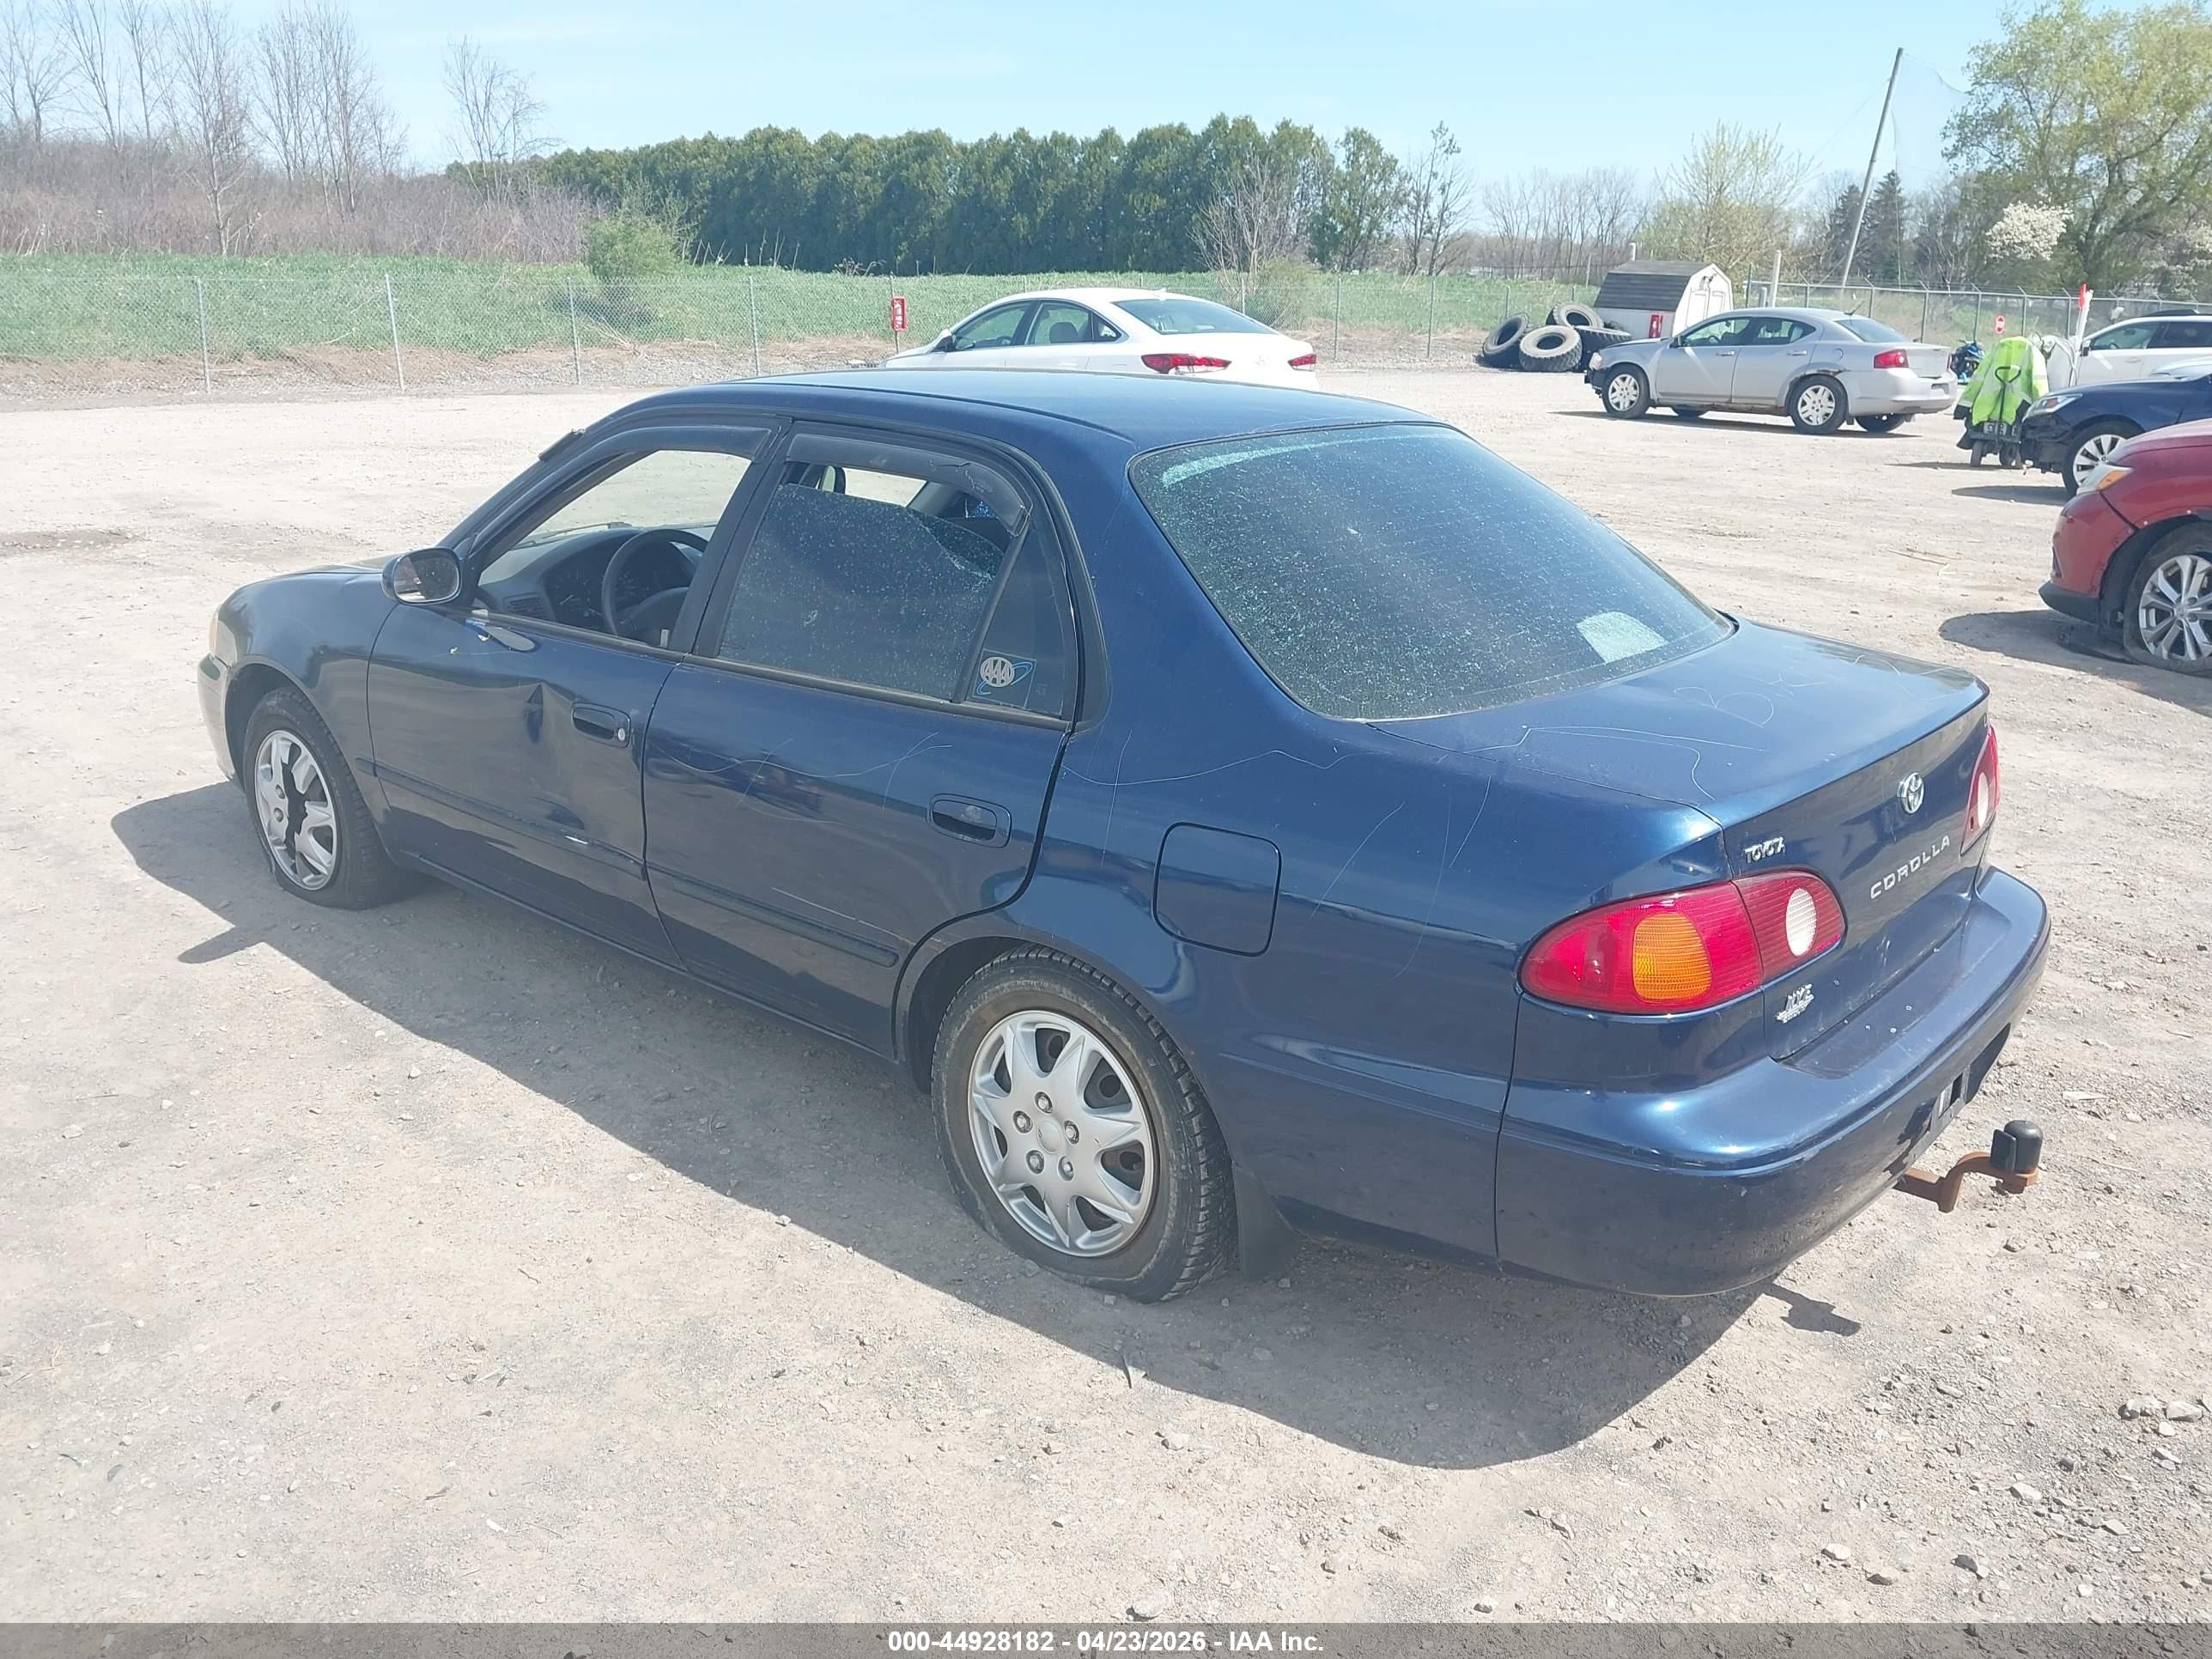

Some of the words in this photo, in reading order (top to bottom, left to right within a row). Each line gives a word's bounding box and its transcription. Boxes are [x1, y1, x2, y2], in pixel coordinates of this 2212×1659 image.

[981, 658, 1013, 686] AAA
[1744, 836, 1786, 864] TOYOTA
[1869, 834, 1951, 900] COROLLA
